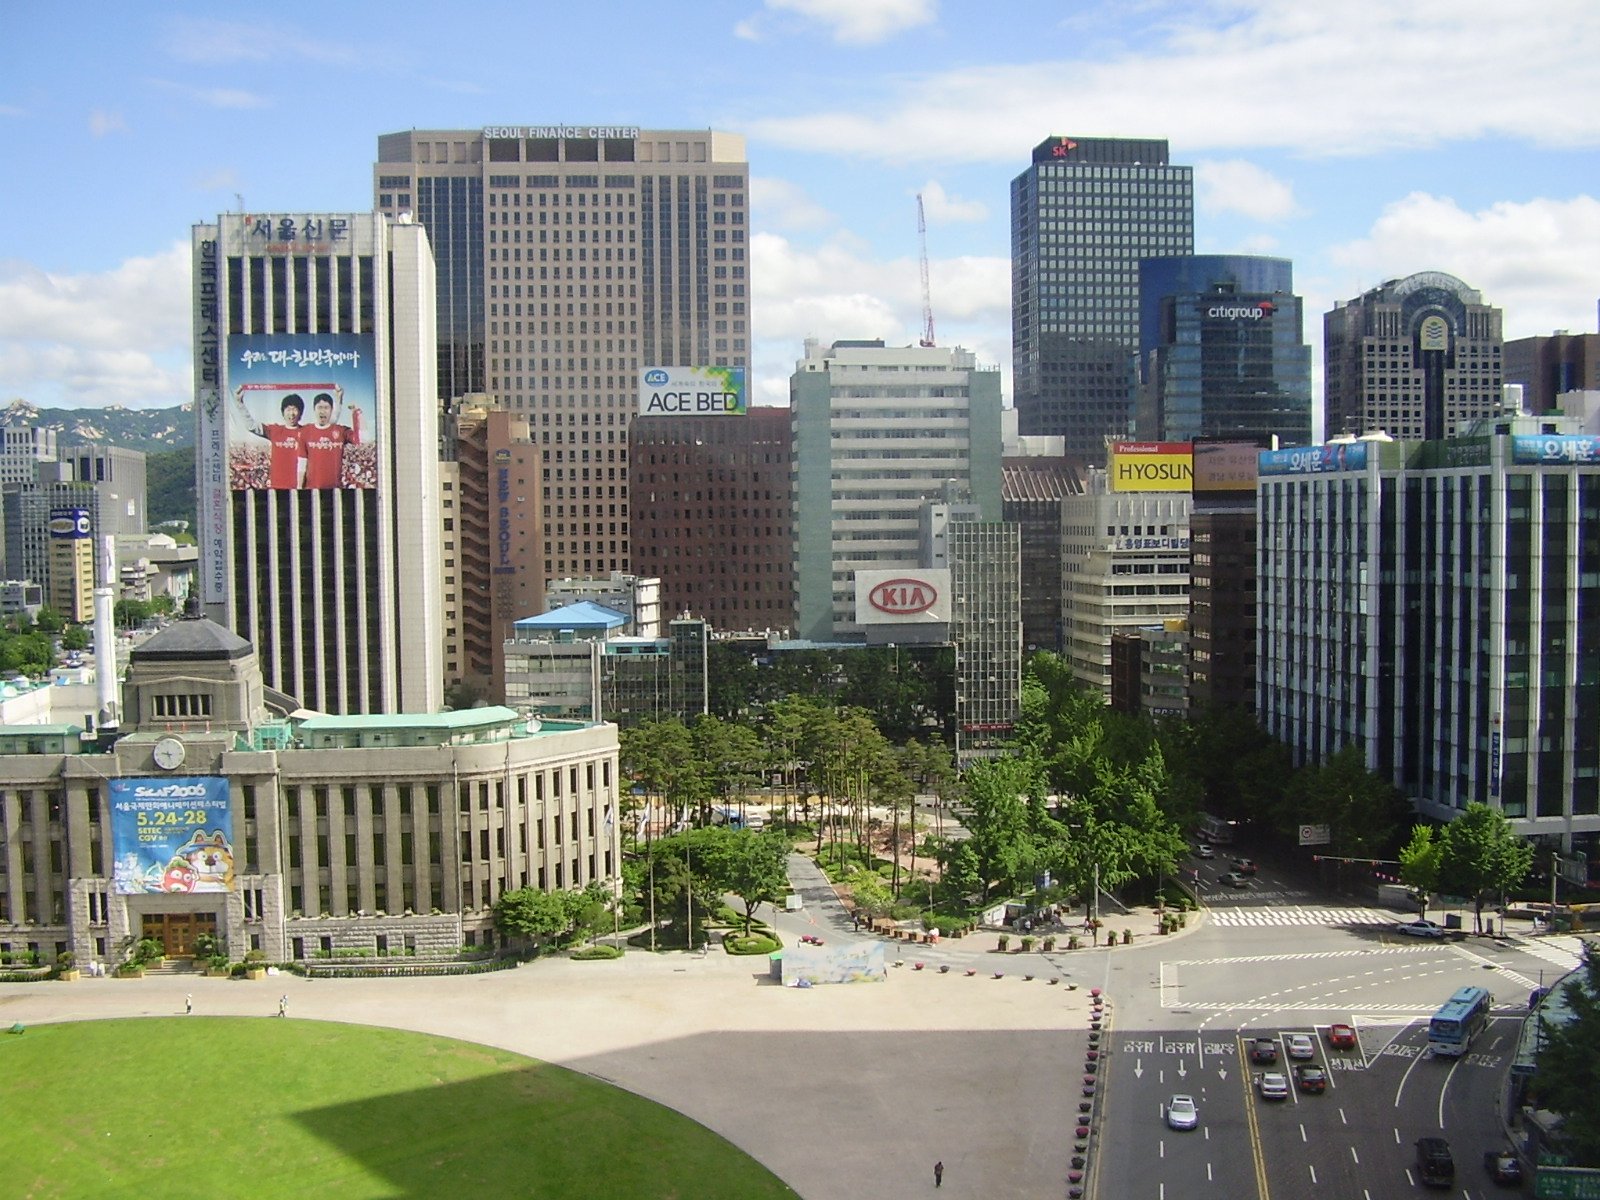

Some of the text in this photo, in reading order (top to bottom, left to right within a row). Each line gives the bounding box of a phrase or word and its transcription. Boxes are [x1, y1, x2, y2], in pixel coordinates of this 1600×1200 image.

[484, 127, 639, 139] SEOUL FINANCE CENTER
[1052, 146, 1068, 157] SK
[252, 218, 348, 241] 서울신문
[201, 239, 218, 386] 한국프레스센터
[1208, 304, 1263, 321] citigroup
[647, 373, 666, 383] ACE
[647, 392, 738, 412] ACE BED
[1119, 445, 1159, 453] Professional
[1542, 440, 1594, 462] 오세훈
[1289, 449, 1322, 473] 오세훈
[882, 588, 926, 606] KIA
[137, 810, 207, 826] 5.24-28
[138, 827, 162, 835] SETEC
